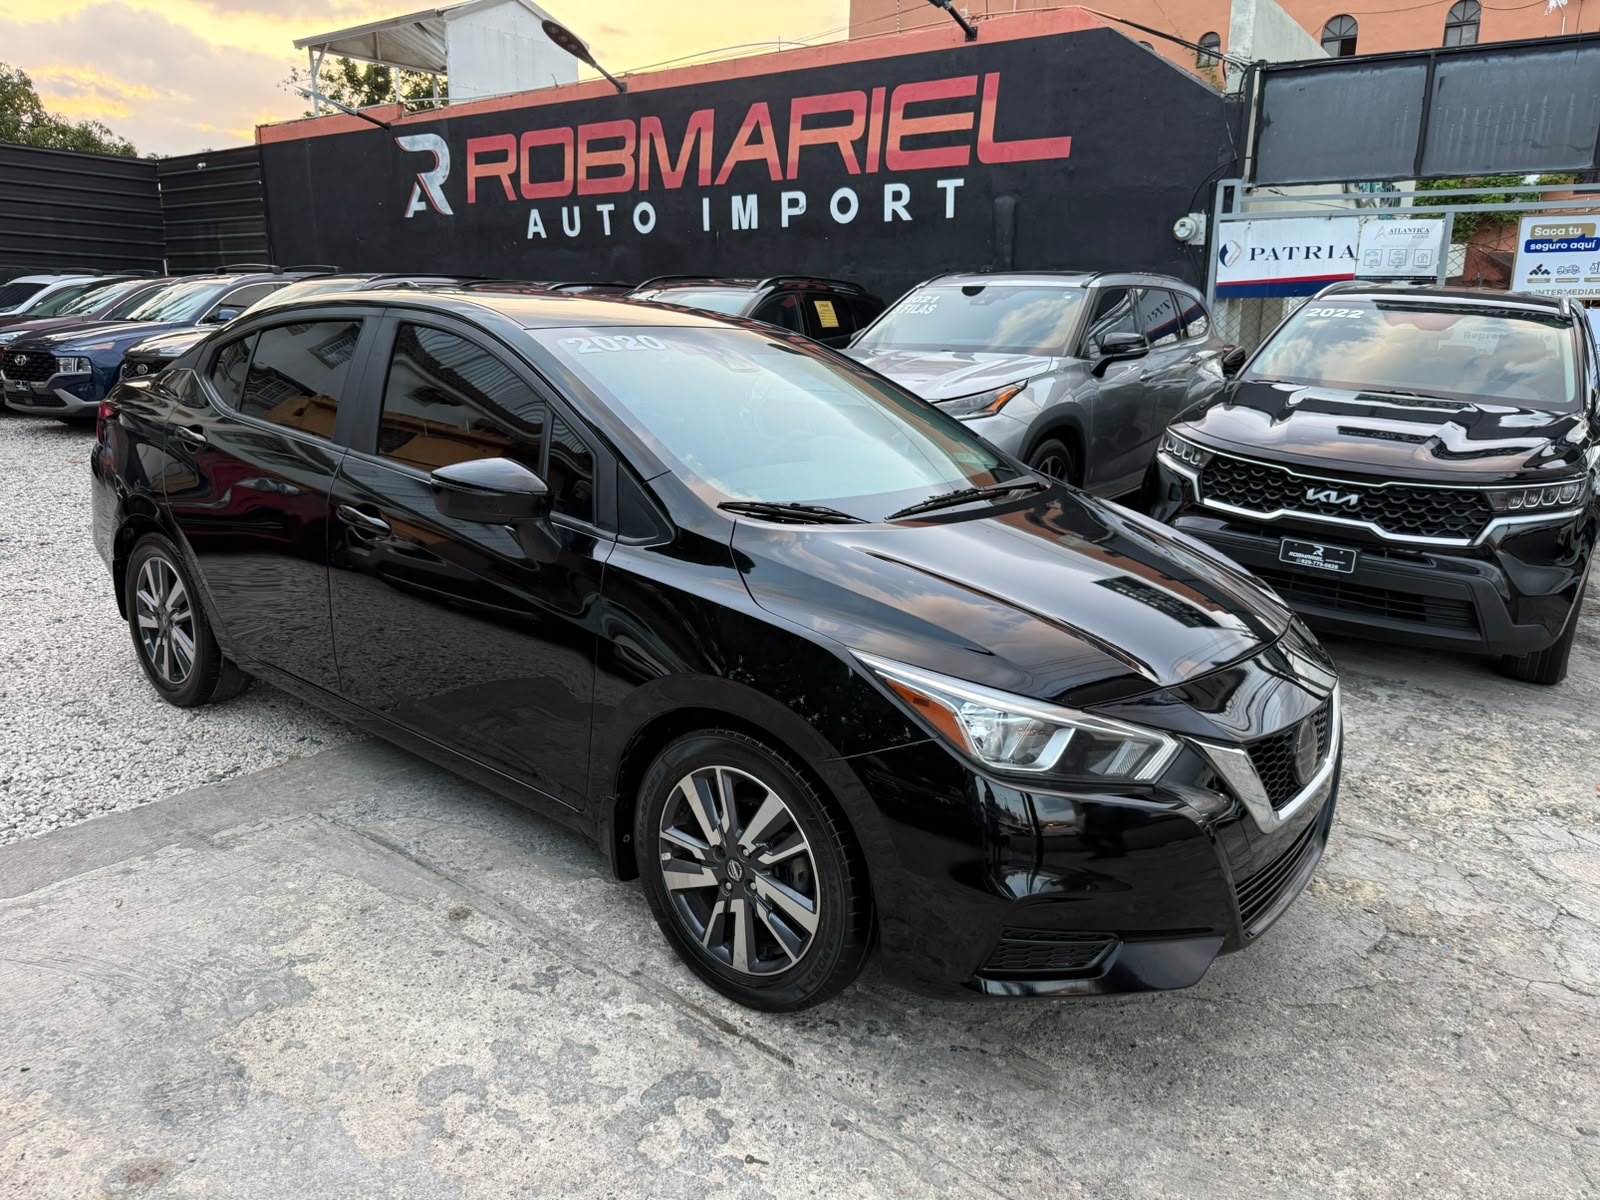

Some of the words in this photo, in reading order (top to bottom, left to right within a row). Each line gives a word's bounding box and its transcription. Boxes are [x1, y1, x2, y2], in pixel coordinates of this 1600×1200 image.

[467, 72, 1072, 204] ROBMARIEL
[527, 201, 656, 239] AUTO
[703, 178, 965, 232] IMPORT
[1534, 227, 1566, 236] Saca
[1569, 226, 1582, 235] tu
[1249, 244, 1356, 261] PATRIA
[1530, 242, 1568, 251] seguro
[1570, 240, 1597, 250] aquí
[1305, 308, 1365, 319] 2022
[566, 335, 666, 354] 2020
